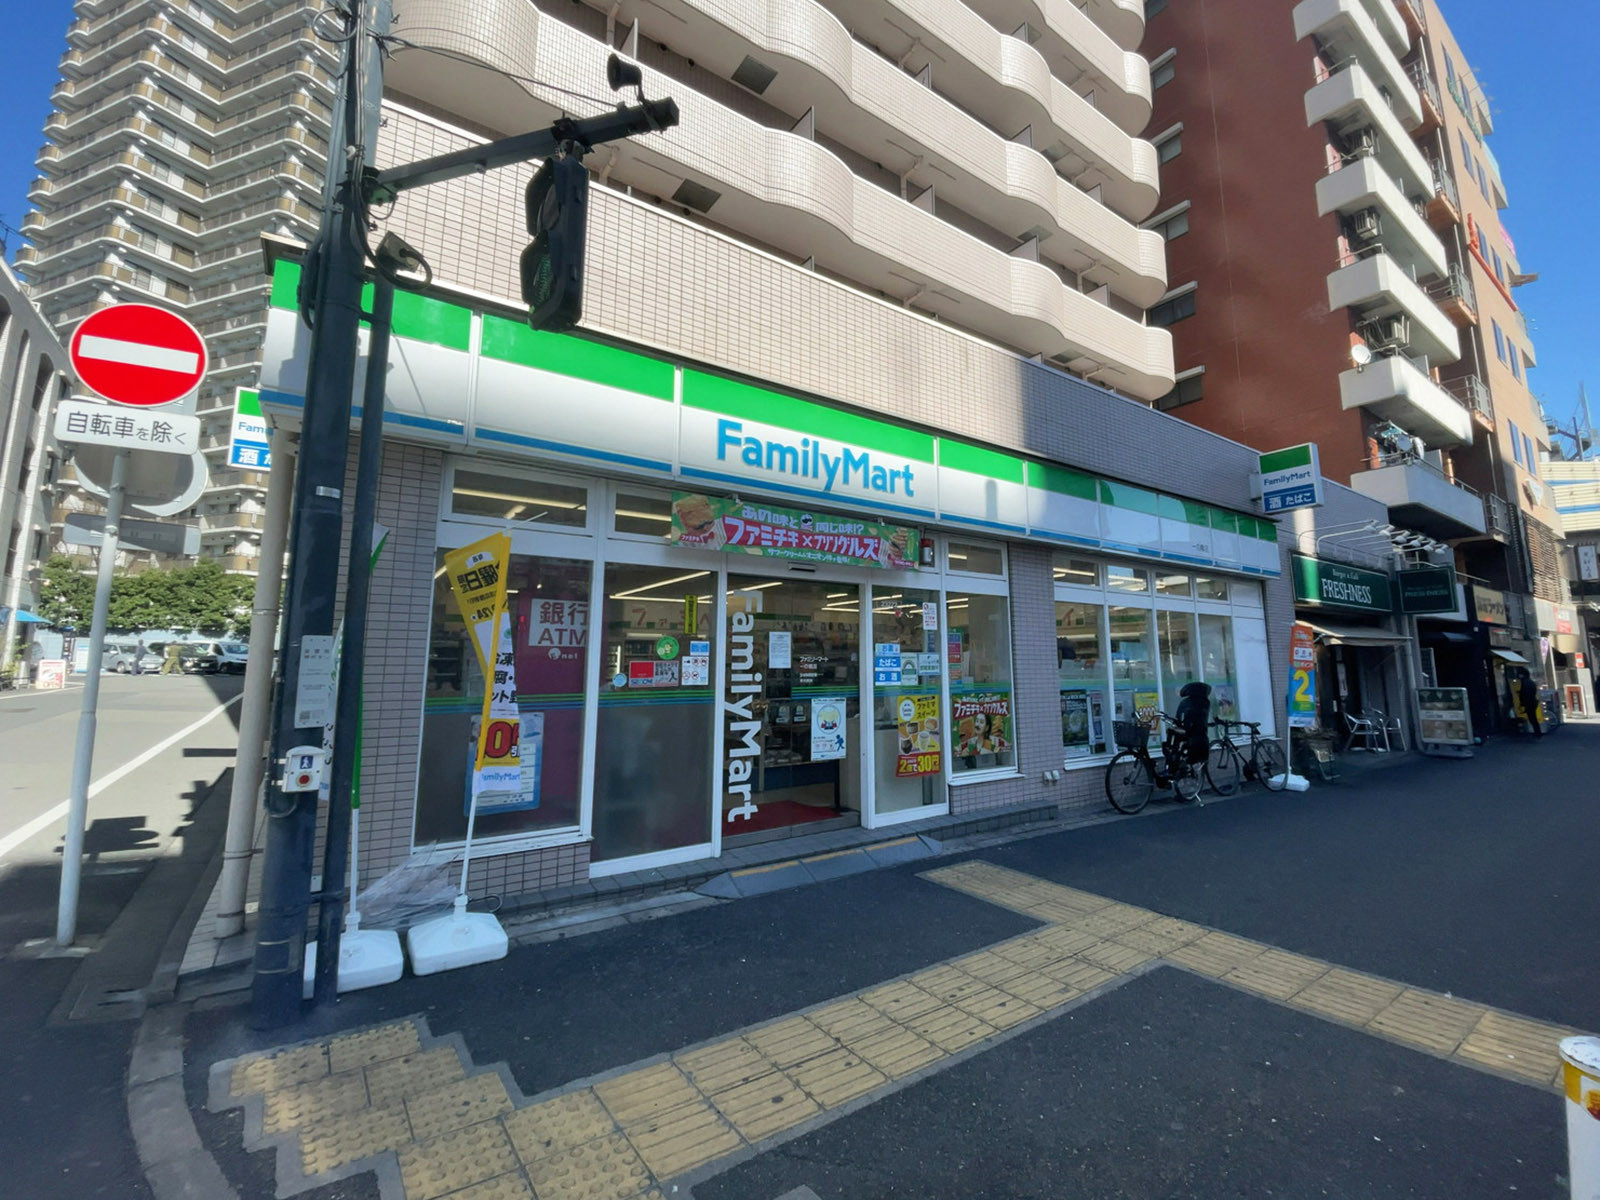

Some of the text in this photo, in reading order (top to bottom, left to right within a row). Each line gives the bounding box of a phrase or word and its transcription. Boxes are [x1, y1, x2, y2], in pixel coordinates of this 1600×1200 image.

[66, 410, 188, 445] 自転車を除く
[239, 448, 259, 465] 酒
[717, 418, 914, 498] FamilyMart
[1263, 470, 1311, 486] FamilyMart
[1269, 493, 1312, 509] 酒 たばこ
[742, 505, 798, 529] あの味と
[1321, 578, 1372, 604] FRESHNESS
[540, 602, 588, 626] 銀行
[538, 628, 586, 645] ATM
[1293, 670, 1310, 702] 2
[724, 590, 763, 823] FamilyMart
